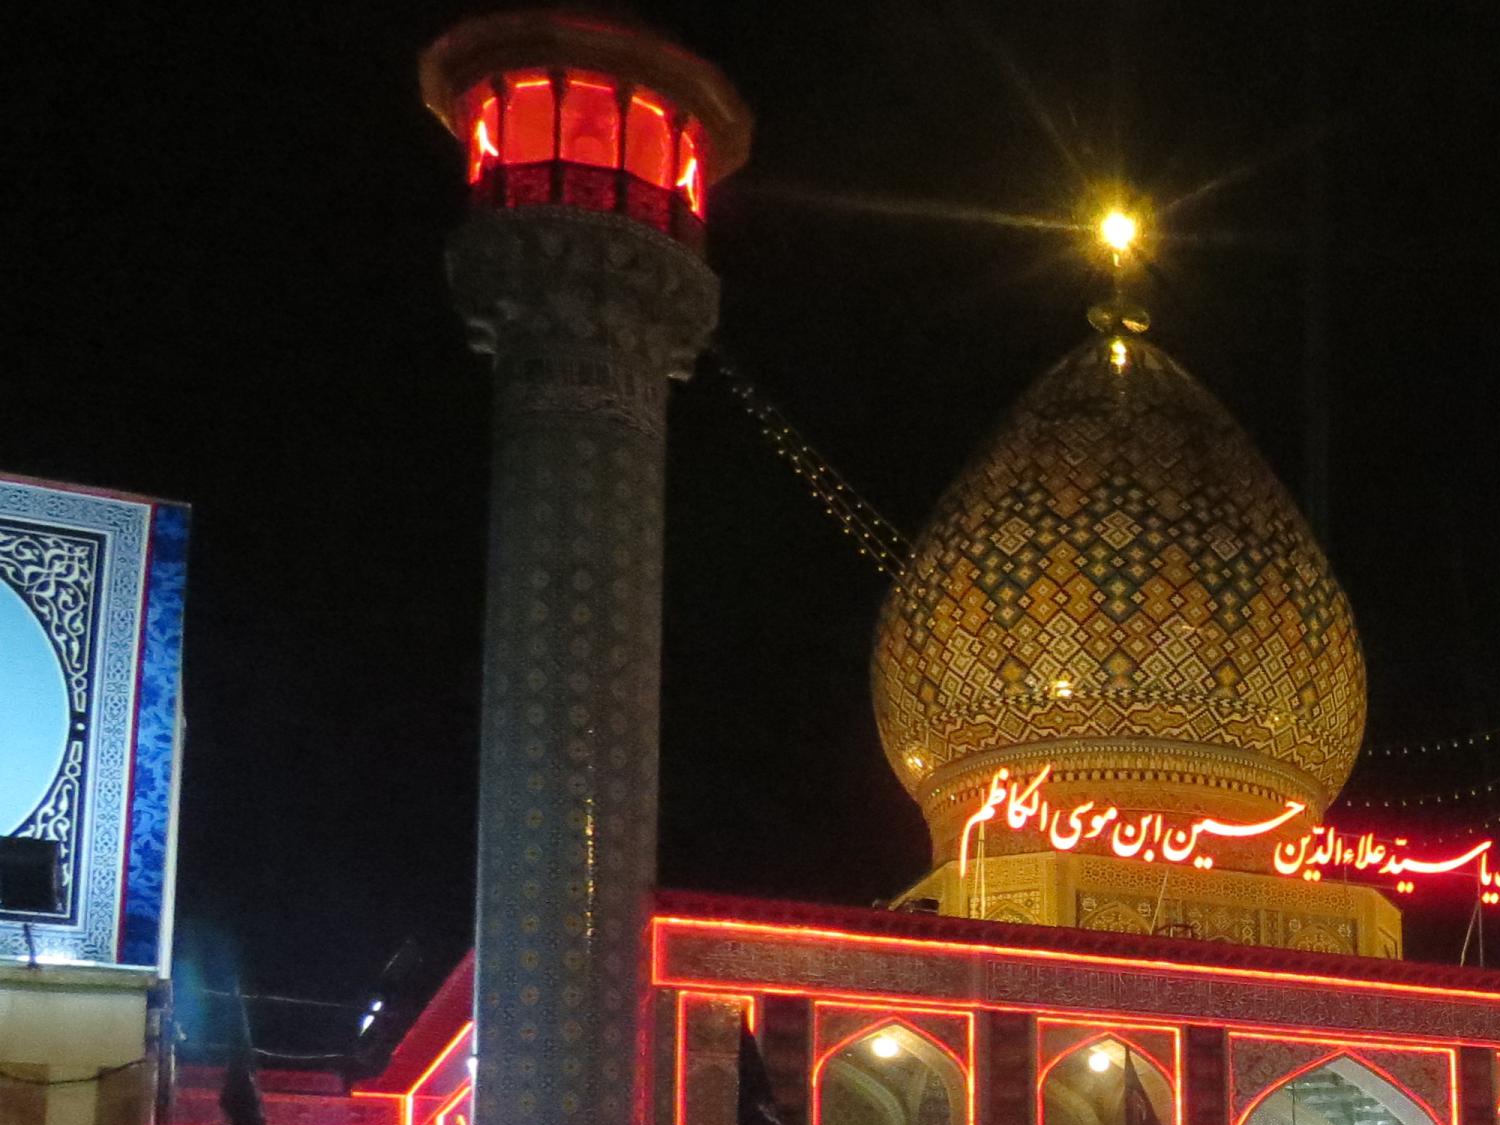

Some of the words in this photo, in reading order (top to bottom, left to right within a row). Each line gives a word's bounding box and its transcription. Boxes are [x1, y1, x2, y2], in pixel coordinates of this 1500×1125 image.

[959, 763, 1052, 879] الکاظم
[1049, 799, 1118, 851] موسی
[1112, 811, 1163, 863] ابن
[1162, 798, 1306, 869] حسین
[1480, 850, 1500, 904] یا
